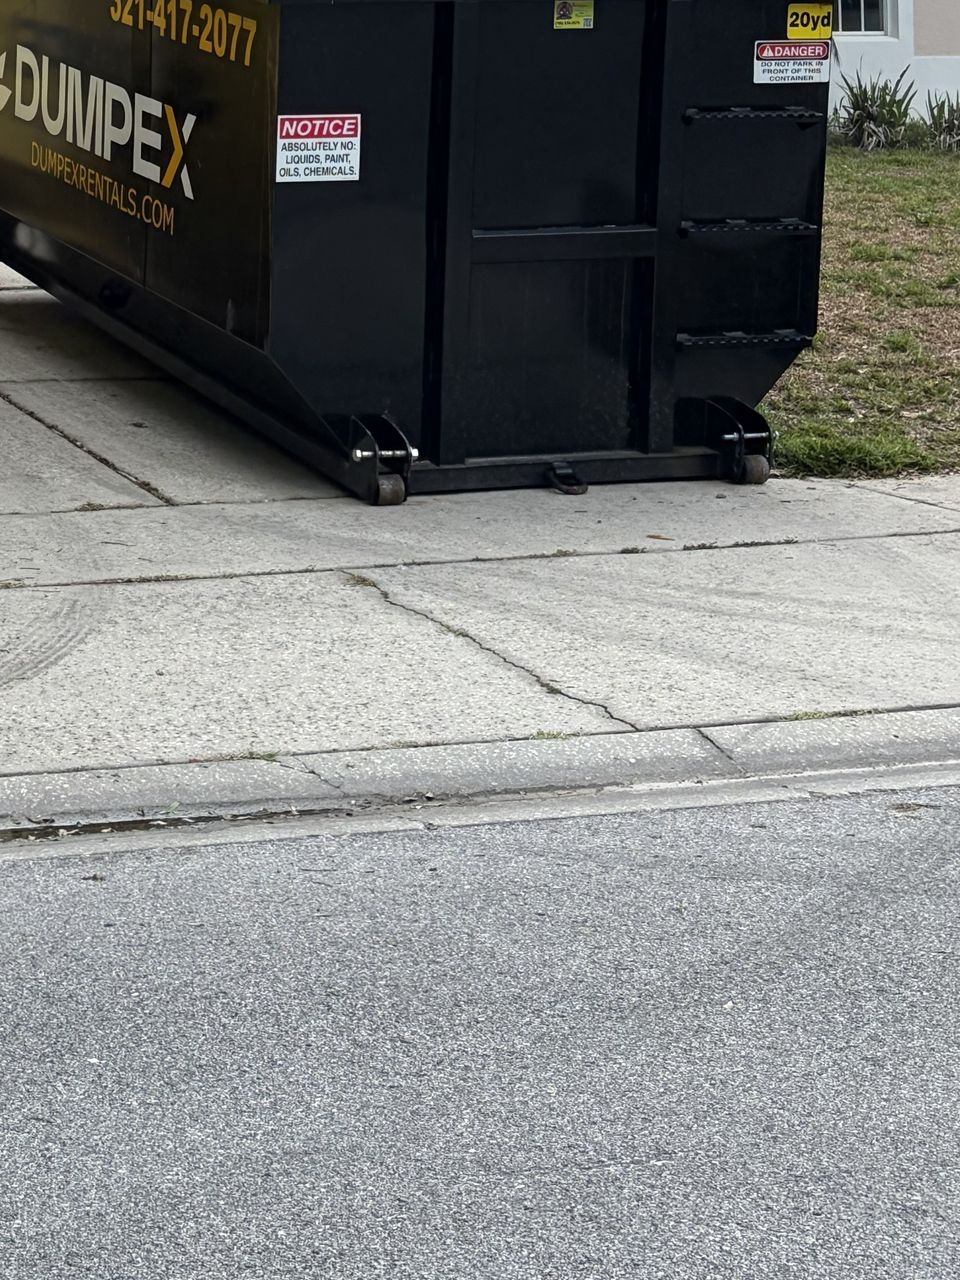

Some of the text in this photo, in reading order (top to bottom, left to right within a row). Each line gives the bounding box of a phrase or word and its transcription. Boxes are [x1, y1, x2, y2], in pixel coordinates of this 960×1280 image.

[789, 11, 831, 31] 20yd
[774, 46, 823, 56] DANGER
[14, 43, 197, 200] DUMPEX
[282, 120, 357, 136] NOTICE
[281, 141, 357, 152] ABSOLUTELY NO:
[285, 154, 351, 165] LIQUIDS, PAINT,
[279, 166, 357, 178] OILS, CHEMICALS.
[31, 141, 175, 236] DUMPEXRENTALS.COM
